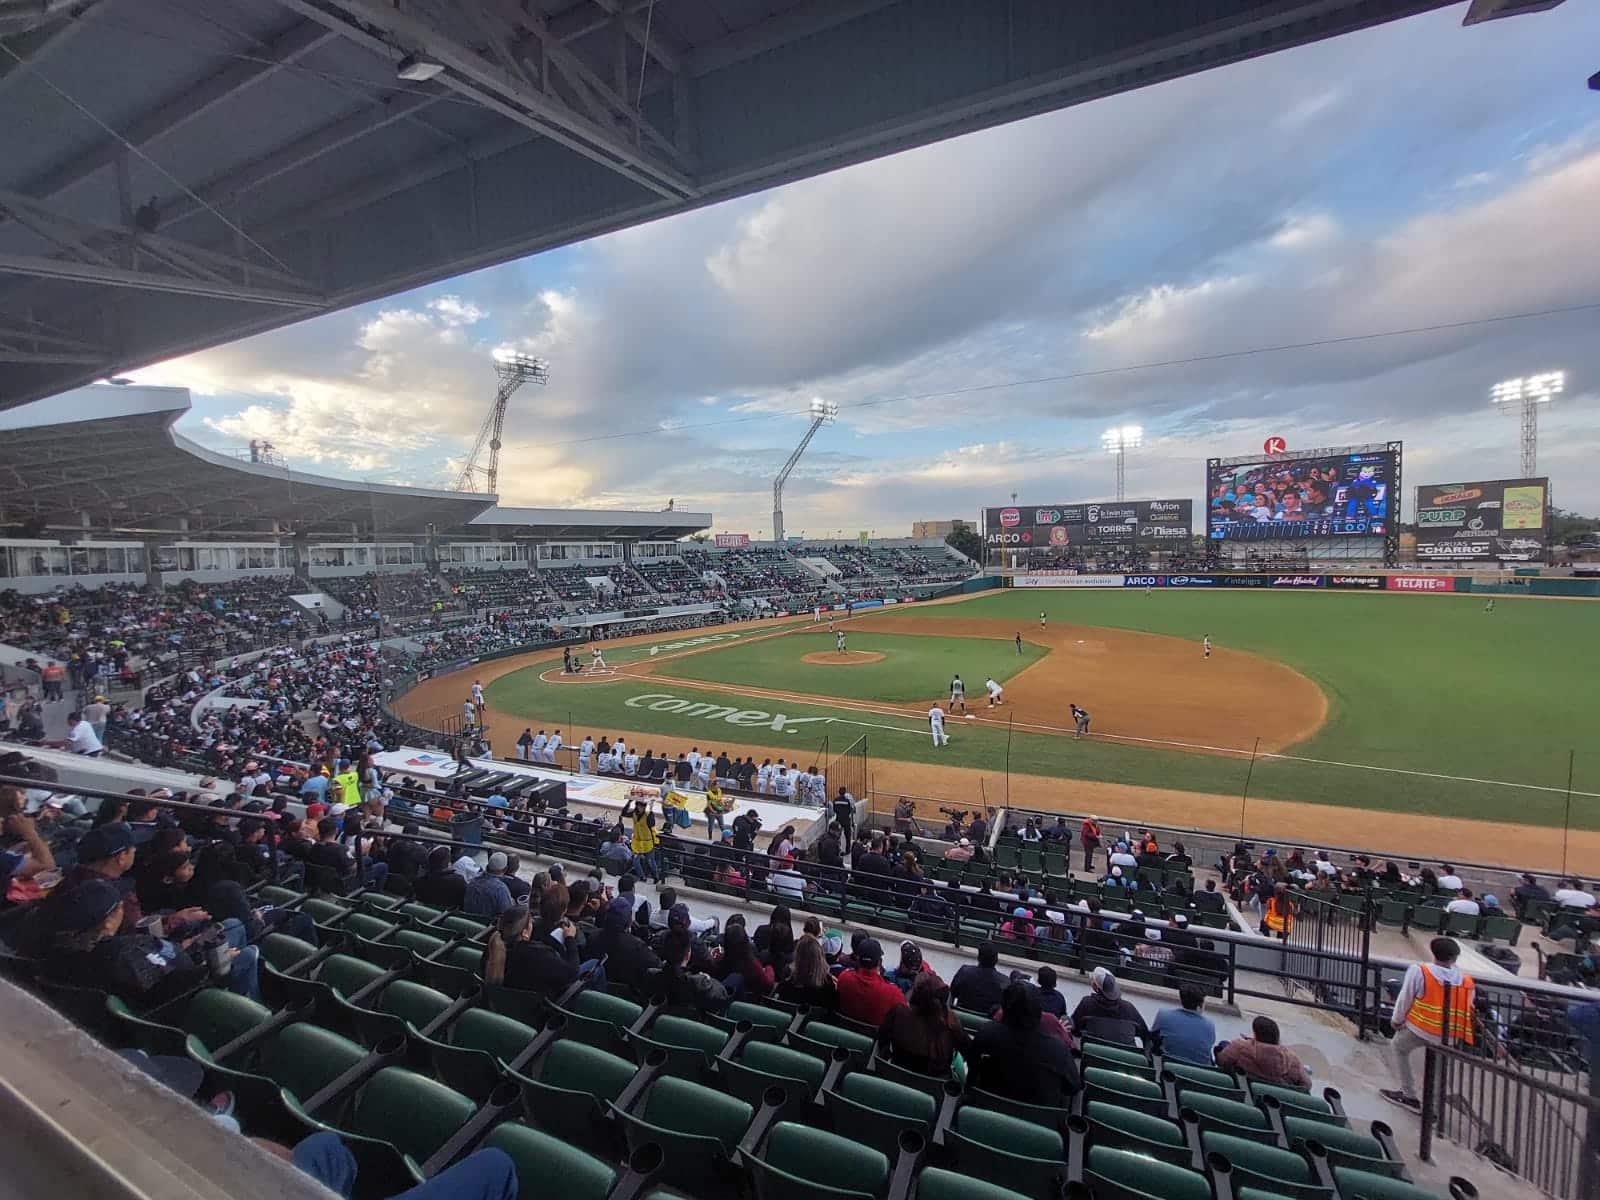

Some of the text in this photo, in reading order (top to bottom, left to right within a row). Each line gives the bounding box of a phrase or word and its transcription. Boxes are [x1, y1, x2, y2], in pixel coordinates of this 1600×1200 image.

[988, 533, 1020, 544] ARCO
[1127, 577, 1156, 585] ARCO
[1395, 578, 1436, 588] TECATE
